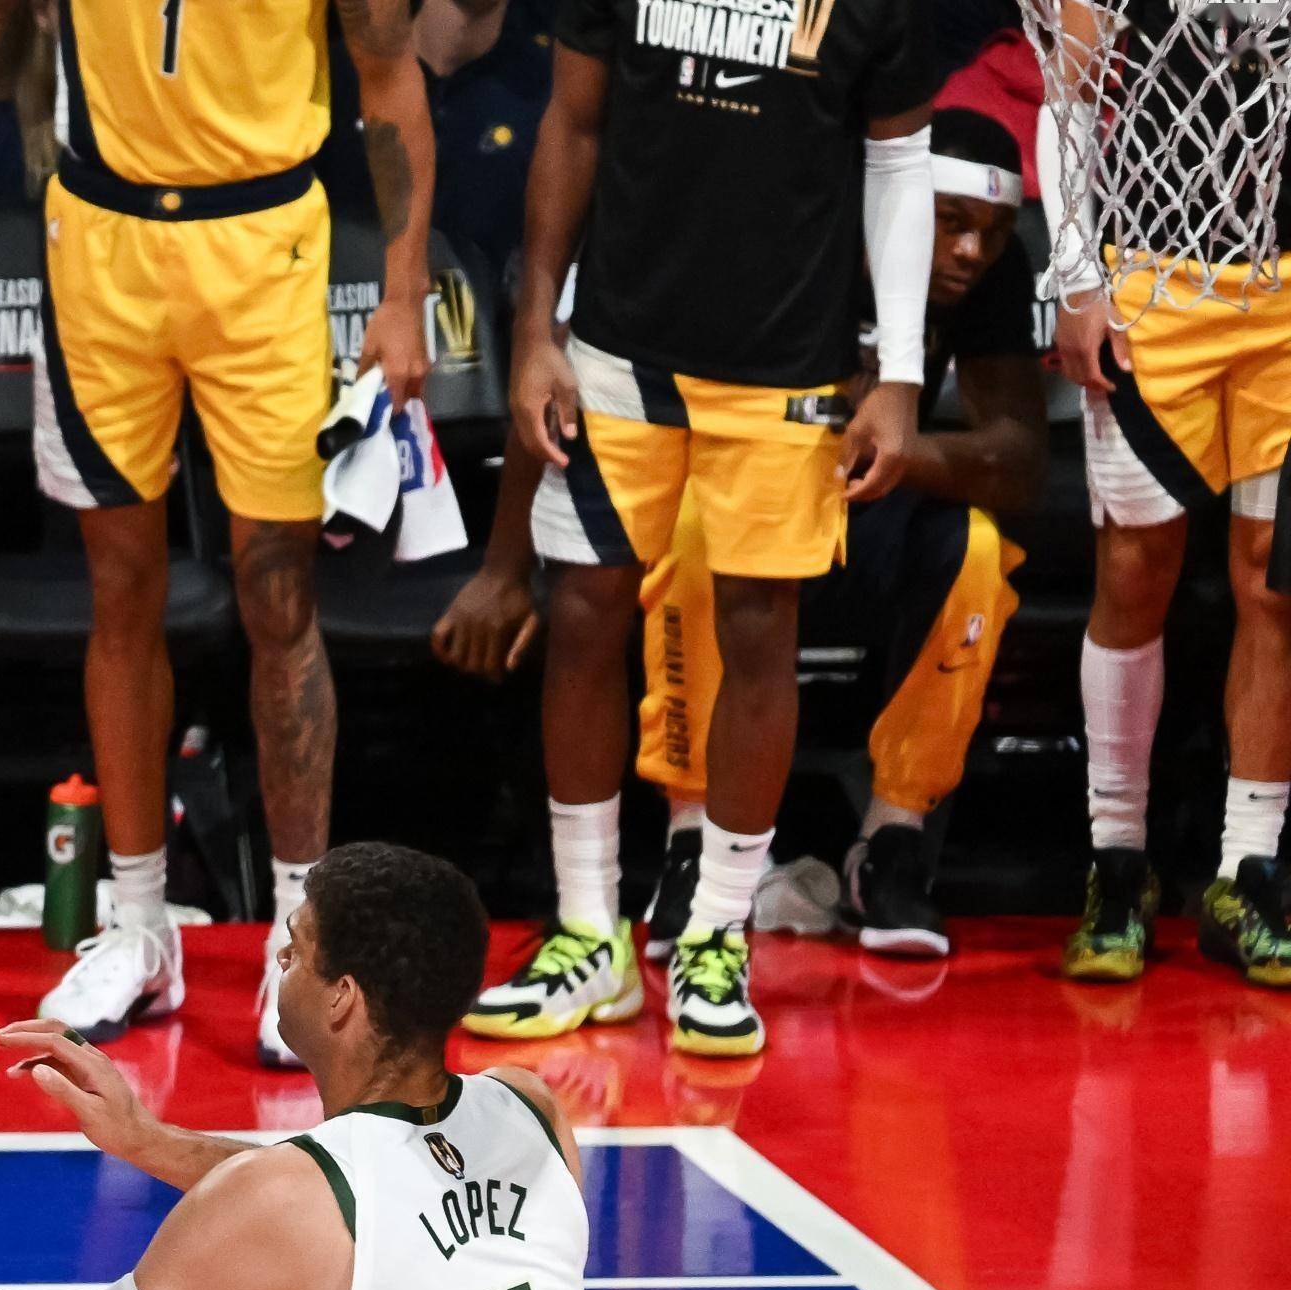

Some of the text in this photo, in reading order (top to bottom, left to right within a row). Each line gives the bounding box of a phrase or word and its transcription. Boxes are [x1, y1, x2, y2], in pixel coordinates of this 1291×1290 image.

[161, 0, 182, 77] 1
[635, 0, 797, 69] TOURNAMENT
[48, 824, 75, 865] G
[419, 1178, 528, 1262] LOPEZ
